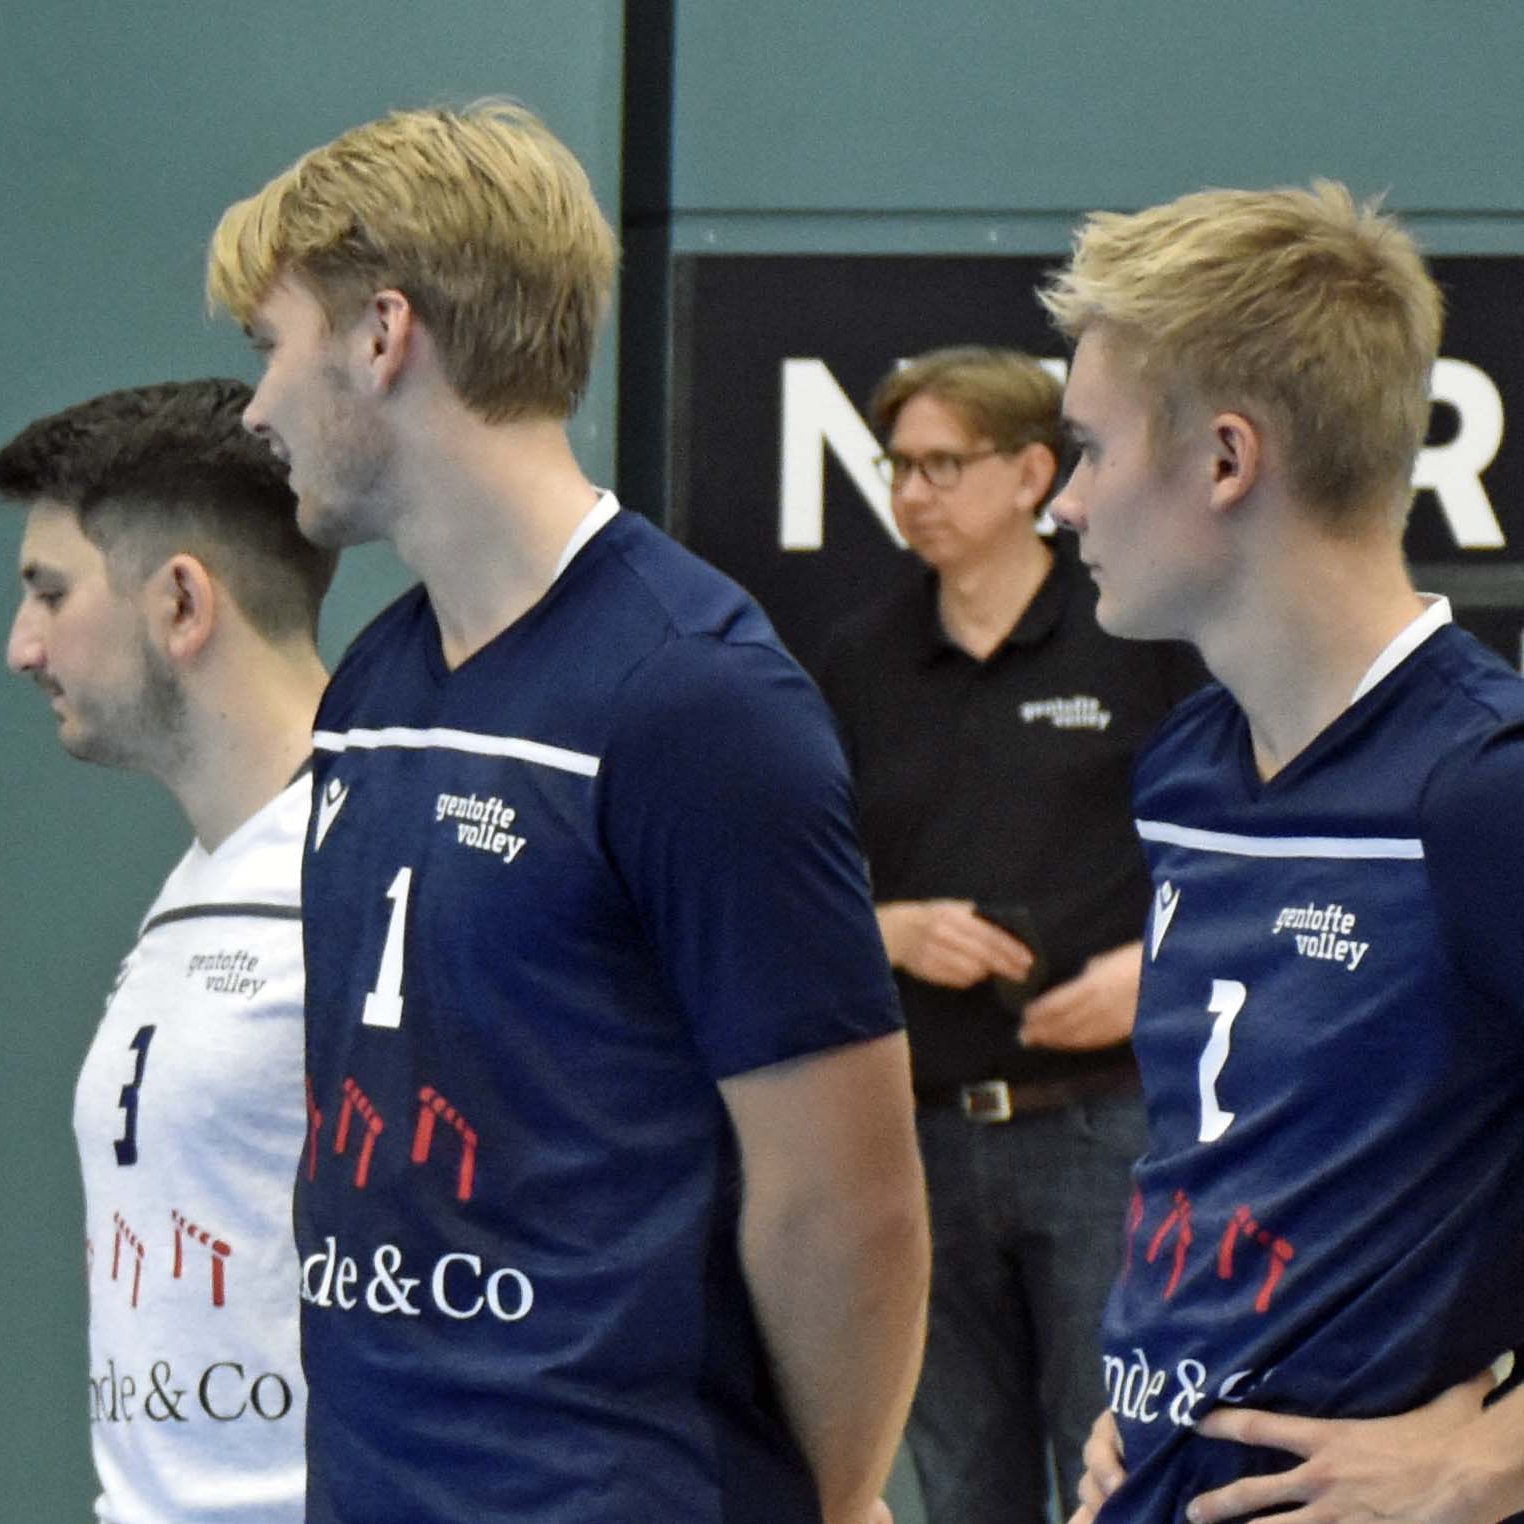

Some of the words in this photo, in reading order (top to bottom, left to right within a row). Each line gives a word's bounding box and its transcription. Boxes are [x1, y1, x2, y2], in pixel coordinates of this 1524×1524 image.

[435, 792, 516, 829] gentofte
[457, 823, 528, 864] volley
[1272, 901, 1356, 935] gentofte
[186, 948, 261, 978] gentofte
[362, 866, 413, 1029] 1
[1294, 932, 1370, 971] volley
[206, 972, 267, 1001] volley
